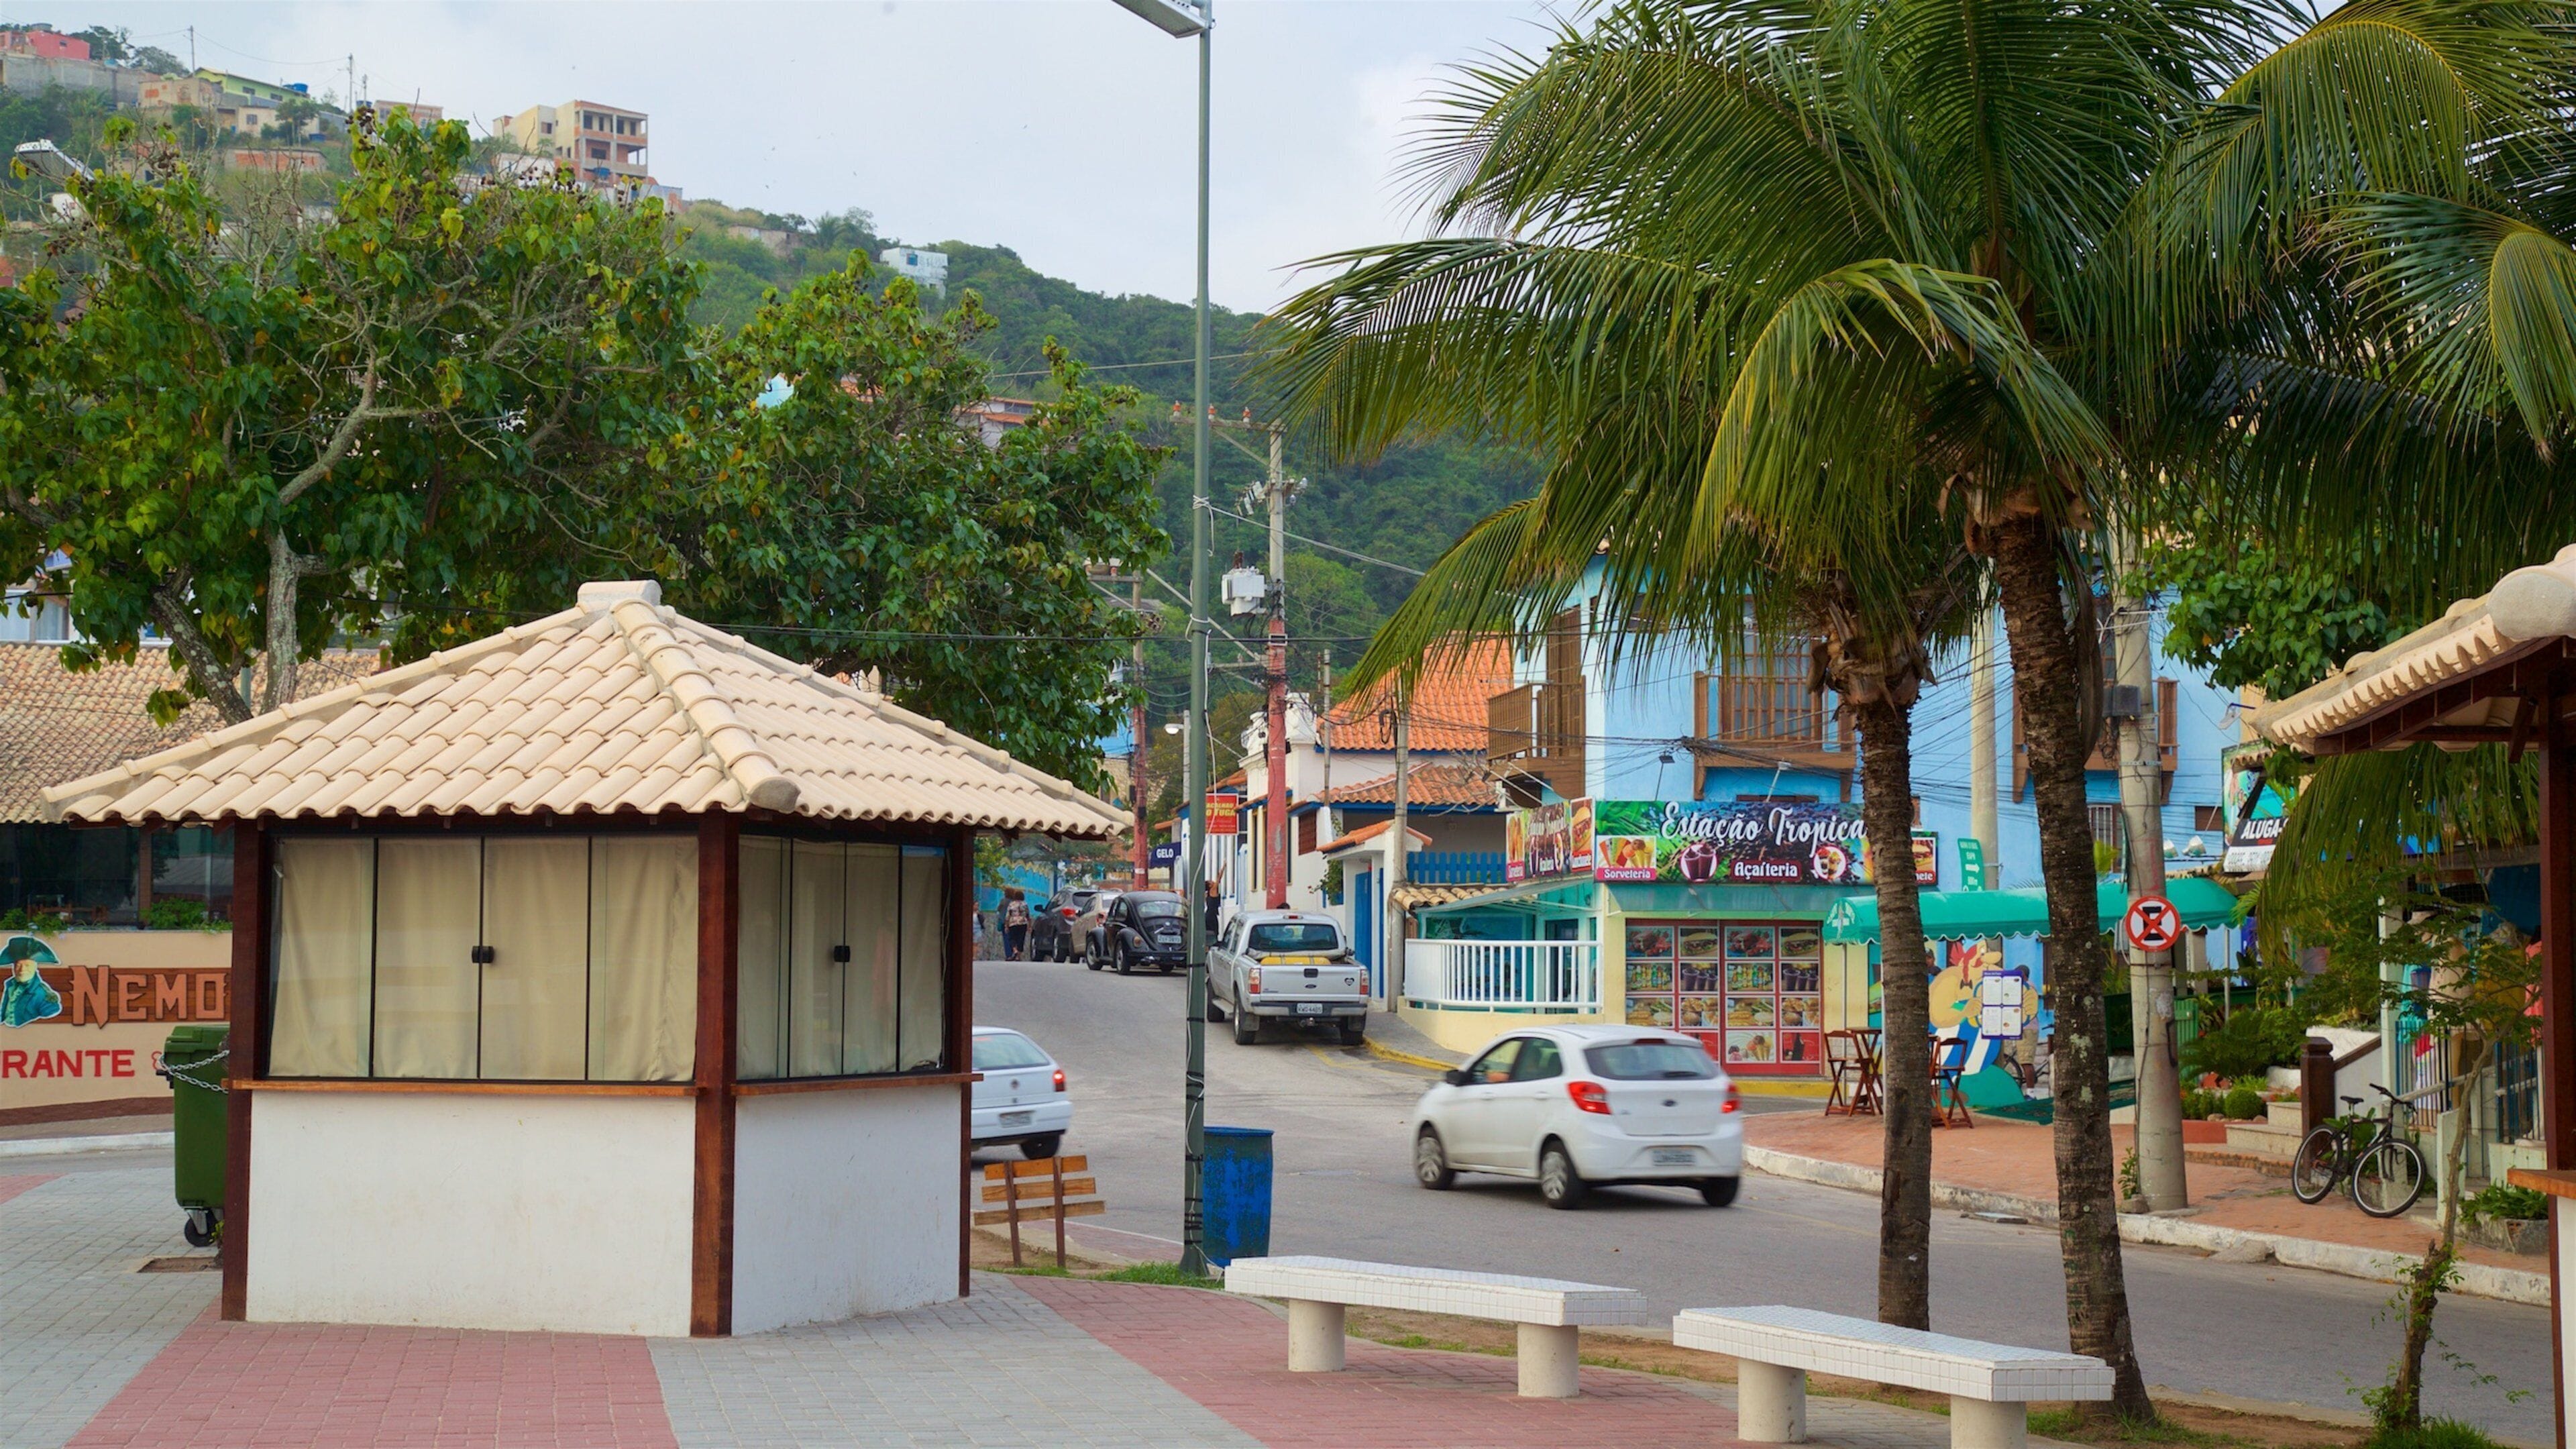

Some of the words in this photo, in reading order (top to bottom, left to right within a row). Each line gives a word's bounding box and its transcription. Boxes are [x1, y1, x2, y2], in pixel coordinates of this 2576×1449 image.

[1661, 801, 1764, 847] Estação
[1768, 807, 1868, 858] Tropica
[1156, 849, 1174, 859] GELO
[1604, 869, 1651, 879] Sorveteria
[1734, 862, 1798, 879] Açaíteria
[68, 965, 227, 1029] NEMO
[0, 1050, 136, 1078] RANTE
